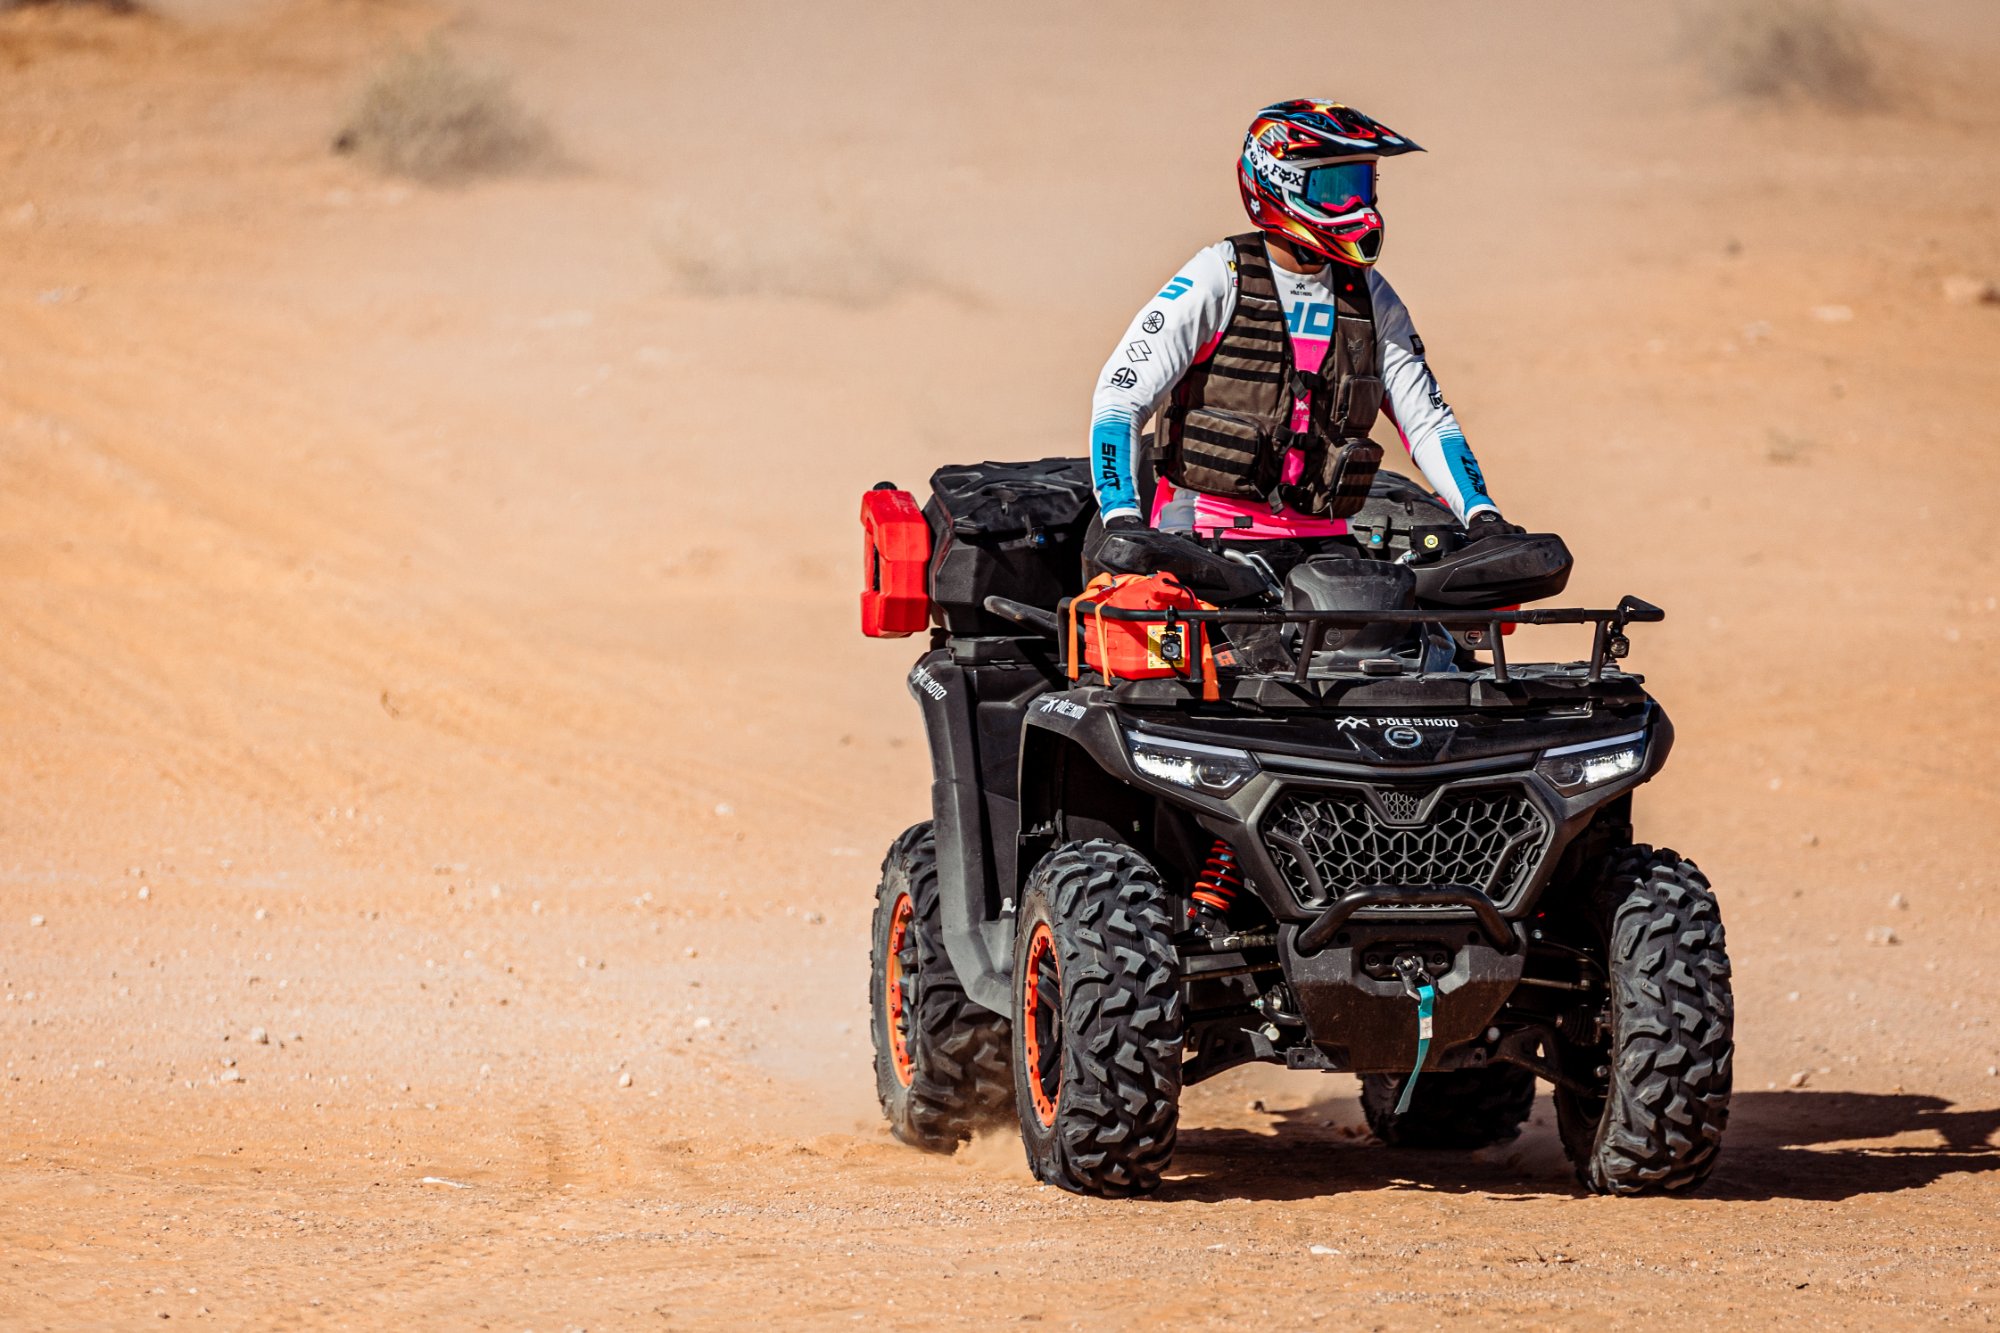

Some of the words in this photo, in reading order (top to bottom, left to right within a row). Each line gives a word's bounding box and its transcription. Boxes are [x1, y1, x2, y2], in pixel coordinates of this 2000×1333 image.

[1101, 442, 1121, 490] SHOT
[924, 678, 947, 700] MOTO
[1424, 718, 1459, 728] MOTO
